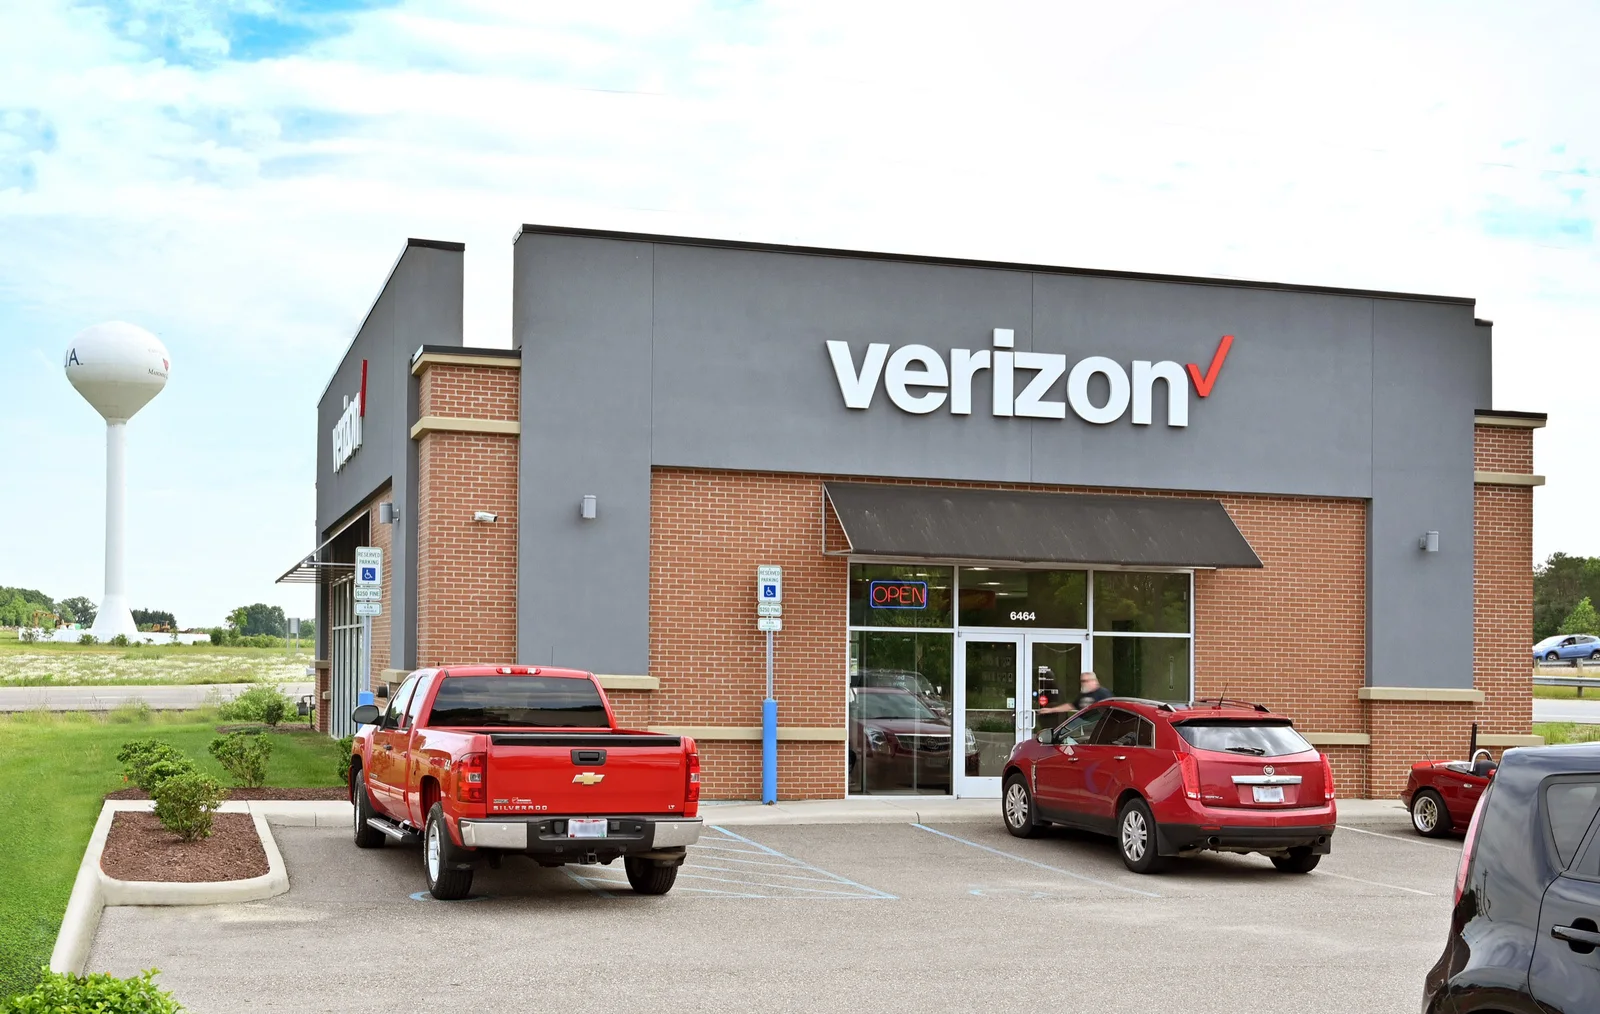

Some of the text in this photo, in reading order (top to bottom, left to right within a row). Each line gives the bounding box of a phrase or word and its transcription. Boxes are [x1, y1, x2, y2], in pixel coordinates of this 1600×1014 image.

[825, 328, 1190, 427] verizon
[872, 586, 926, 604] OPEN
[1010, 611, 1036, 621] 6464
